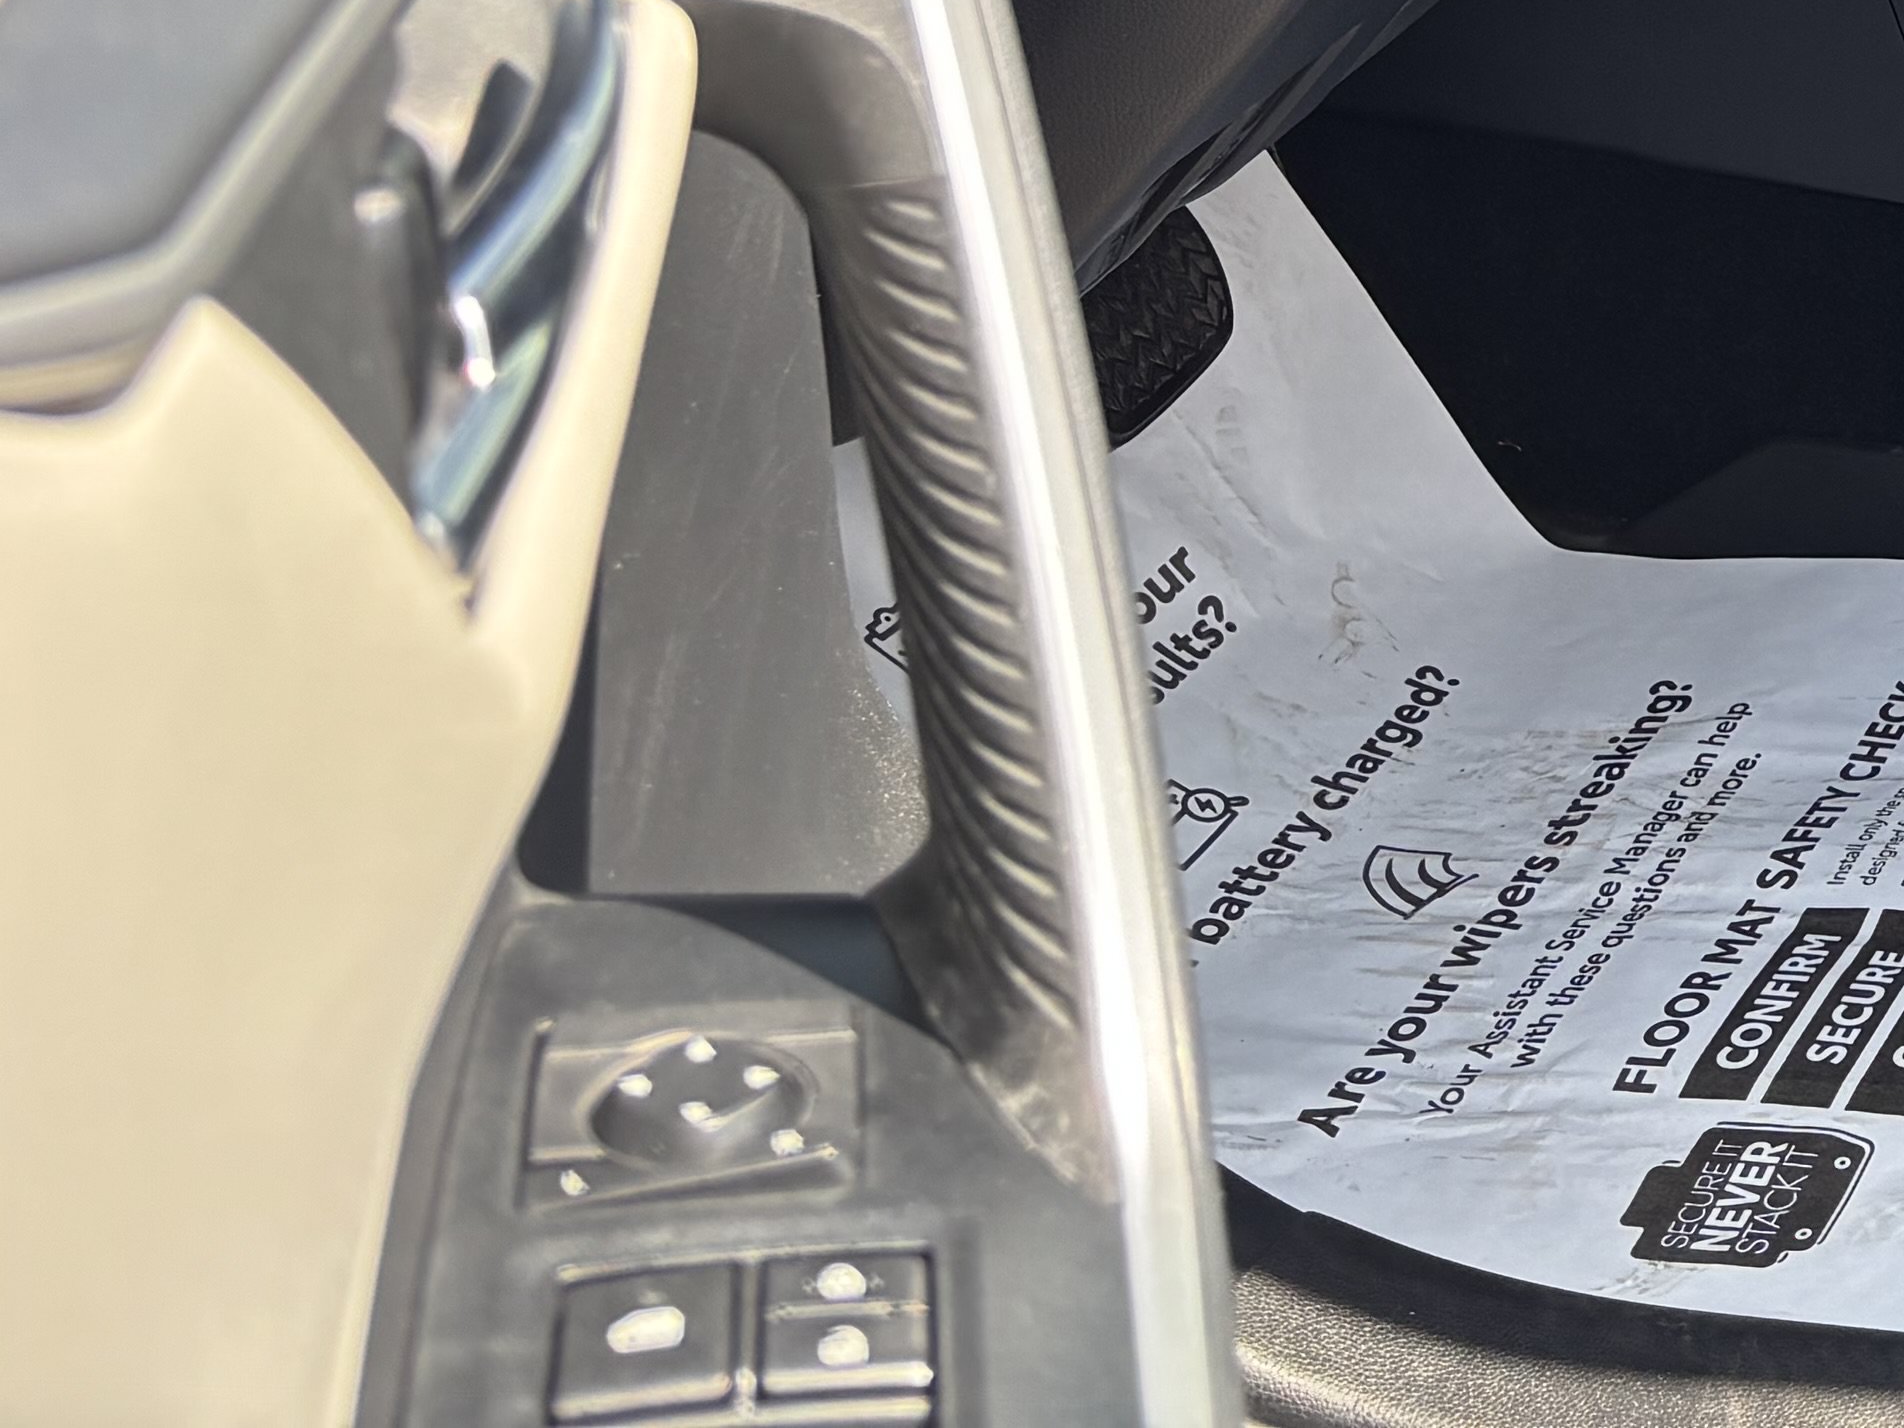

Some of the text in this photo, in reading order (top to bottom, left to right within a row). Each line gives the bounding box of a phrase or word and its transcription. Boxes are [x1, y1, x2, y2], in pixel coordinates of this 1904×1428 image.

[1134, 546, 1197, 624] our
[1310, 665, 1460, 810] charged?
[1298, 680, 1693, 1137] Are your wipers streaking?
[1419, 701, 1754, 1114] Your Assistant Service Manager can help
[1510, 752, 1762, 1068] with these questions and more.
[1826, 843, 1867, 886] Install
[1858, 818, 1888, 841] only
[1876, 800, 1901, 817] the
[1612, 971, 1732, 1093] FLOOR
[1703, 899, 1782, 965] MAT
[1755, 786, 1861, 890] SAFETY
[1715, 933, 1842, 1070] CONFIRM
[1660, 1139, 1744, 1249] SECURE IT
[1690, 1141, 1789, 1252] NEVER
[1735, 1144, 1819, 1254] STACK IT
